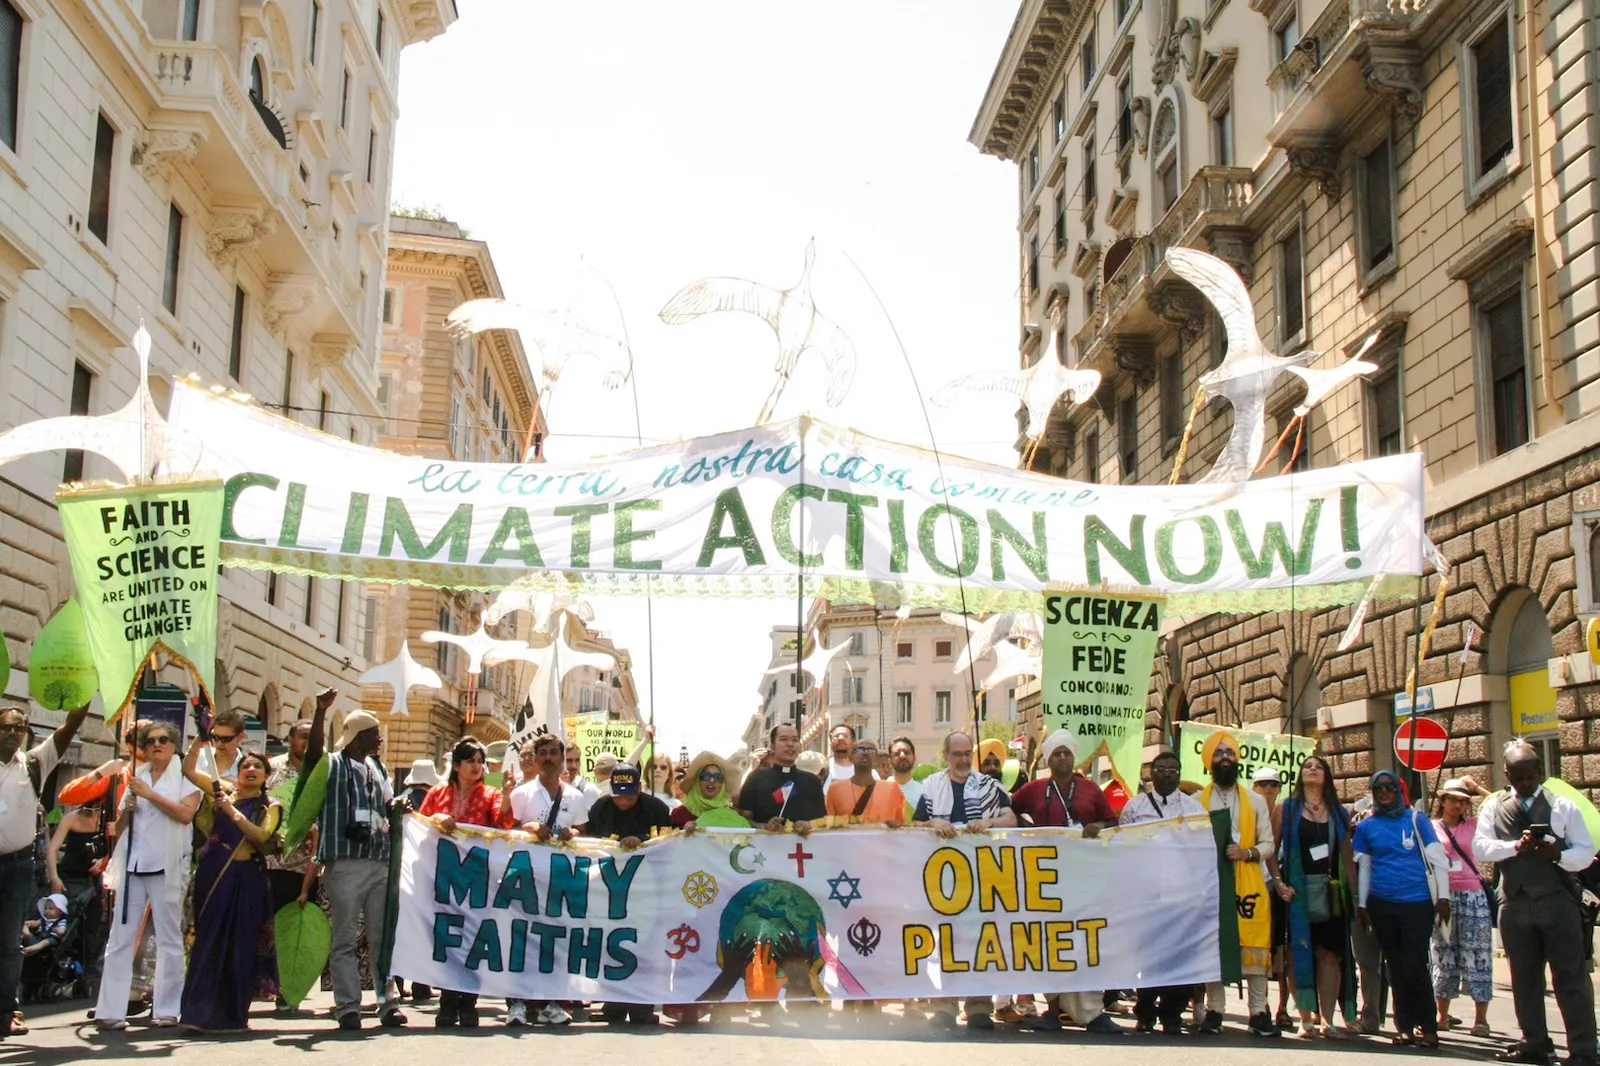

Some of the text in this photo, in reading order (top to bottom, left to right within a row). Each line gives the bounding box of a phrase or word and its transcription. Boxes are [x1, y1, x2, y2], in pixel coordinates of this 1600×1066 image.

[408, 463, 481, 493] la
[653, 439, 806, 488] nostra
[820, 451, 912, 491] casa
[100, 500, 190, 534] FAITH
[219, 471, 1362, 586] CLIMATE ACTION NOW!
[136, 531, 159, 544] AND
[97, 545, 206, 581] SCIENCE
[102, 577, 207, 604] ARE UNITED ON
[123, 599, 191, 623] CLIMATE
[1046, 596, 1158, 631] SCIENZA
[125, 616, 192, 641] CHANGE!
[1101, 632, 1107, 642] E
[1072, 646, 1127, 675] FEDE
[1043, 703, 1143, 719] IL CAMBIO CLIMATICO
[605, 729, 633, 738] WORLD
[434, 838, 645, 919] MANY
[923, 845, 1062, 916] ONE
[432, 912, 638, 981] FAITHS
[903, 918, 1107, 975] PLANET
